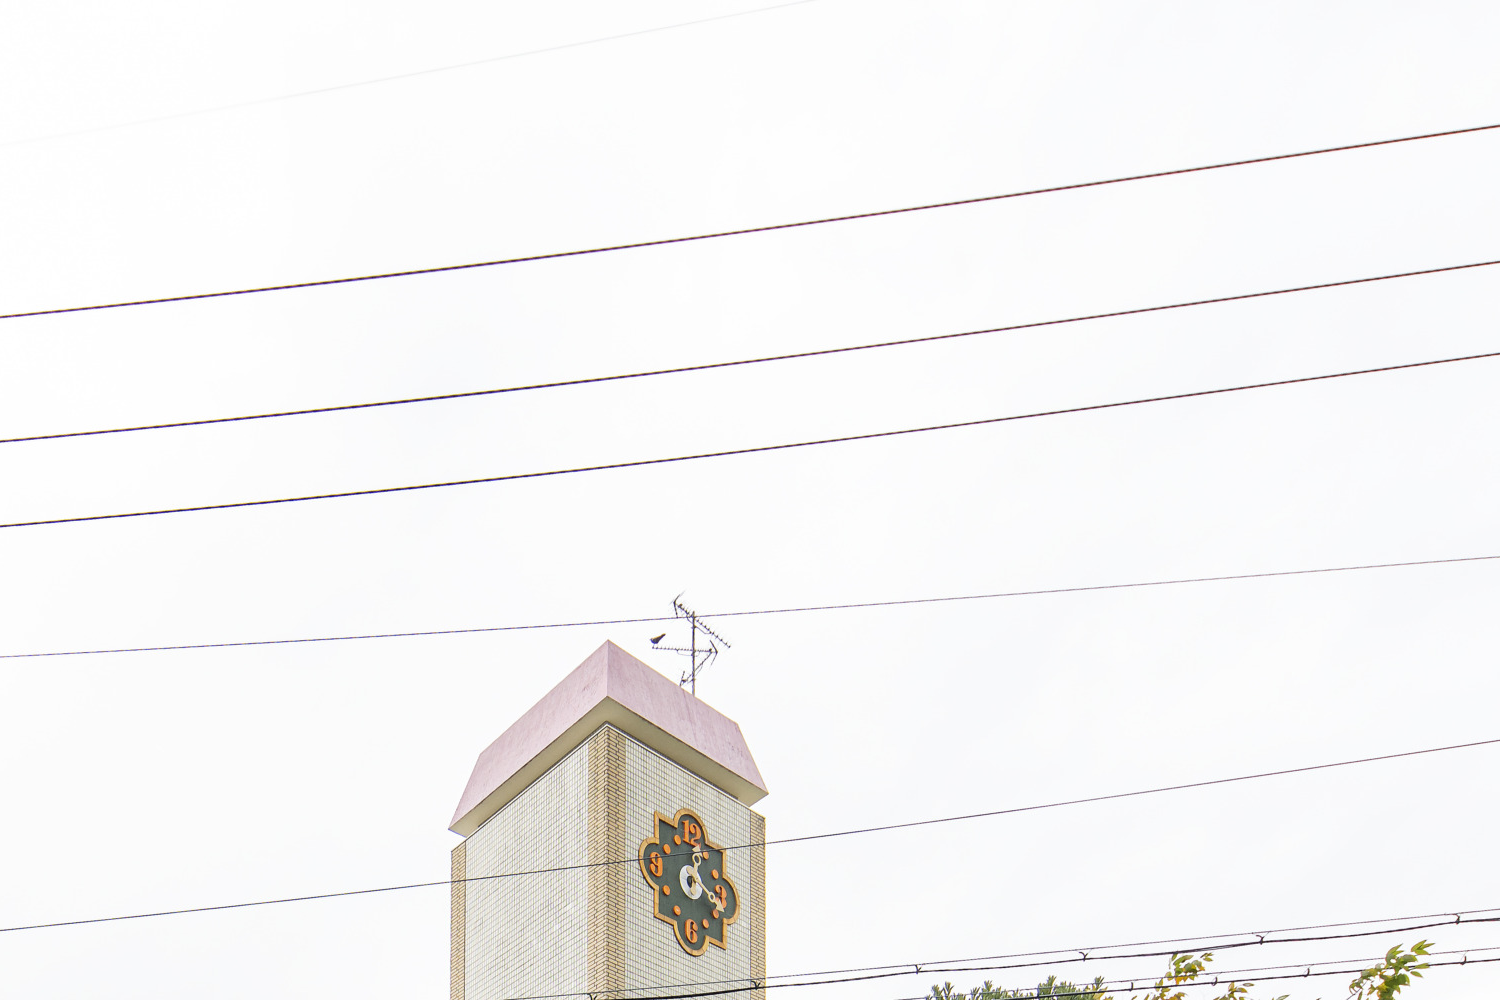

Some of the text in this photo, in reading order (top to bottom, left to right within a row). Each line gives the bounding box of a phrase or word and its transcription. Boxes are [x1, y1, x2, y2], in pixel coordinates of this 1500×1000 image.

[682, 819, 702, 848] 12
[649, 851, 663, 877] 9
[714, 884, 728, 909] 3
[684, 918, 699, 944] 6
